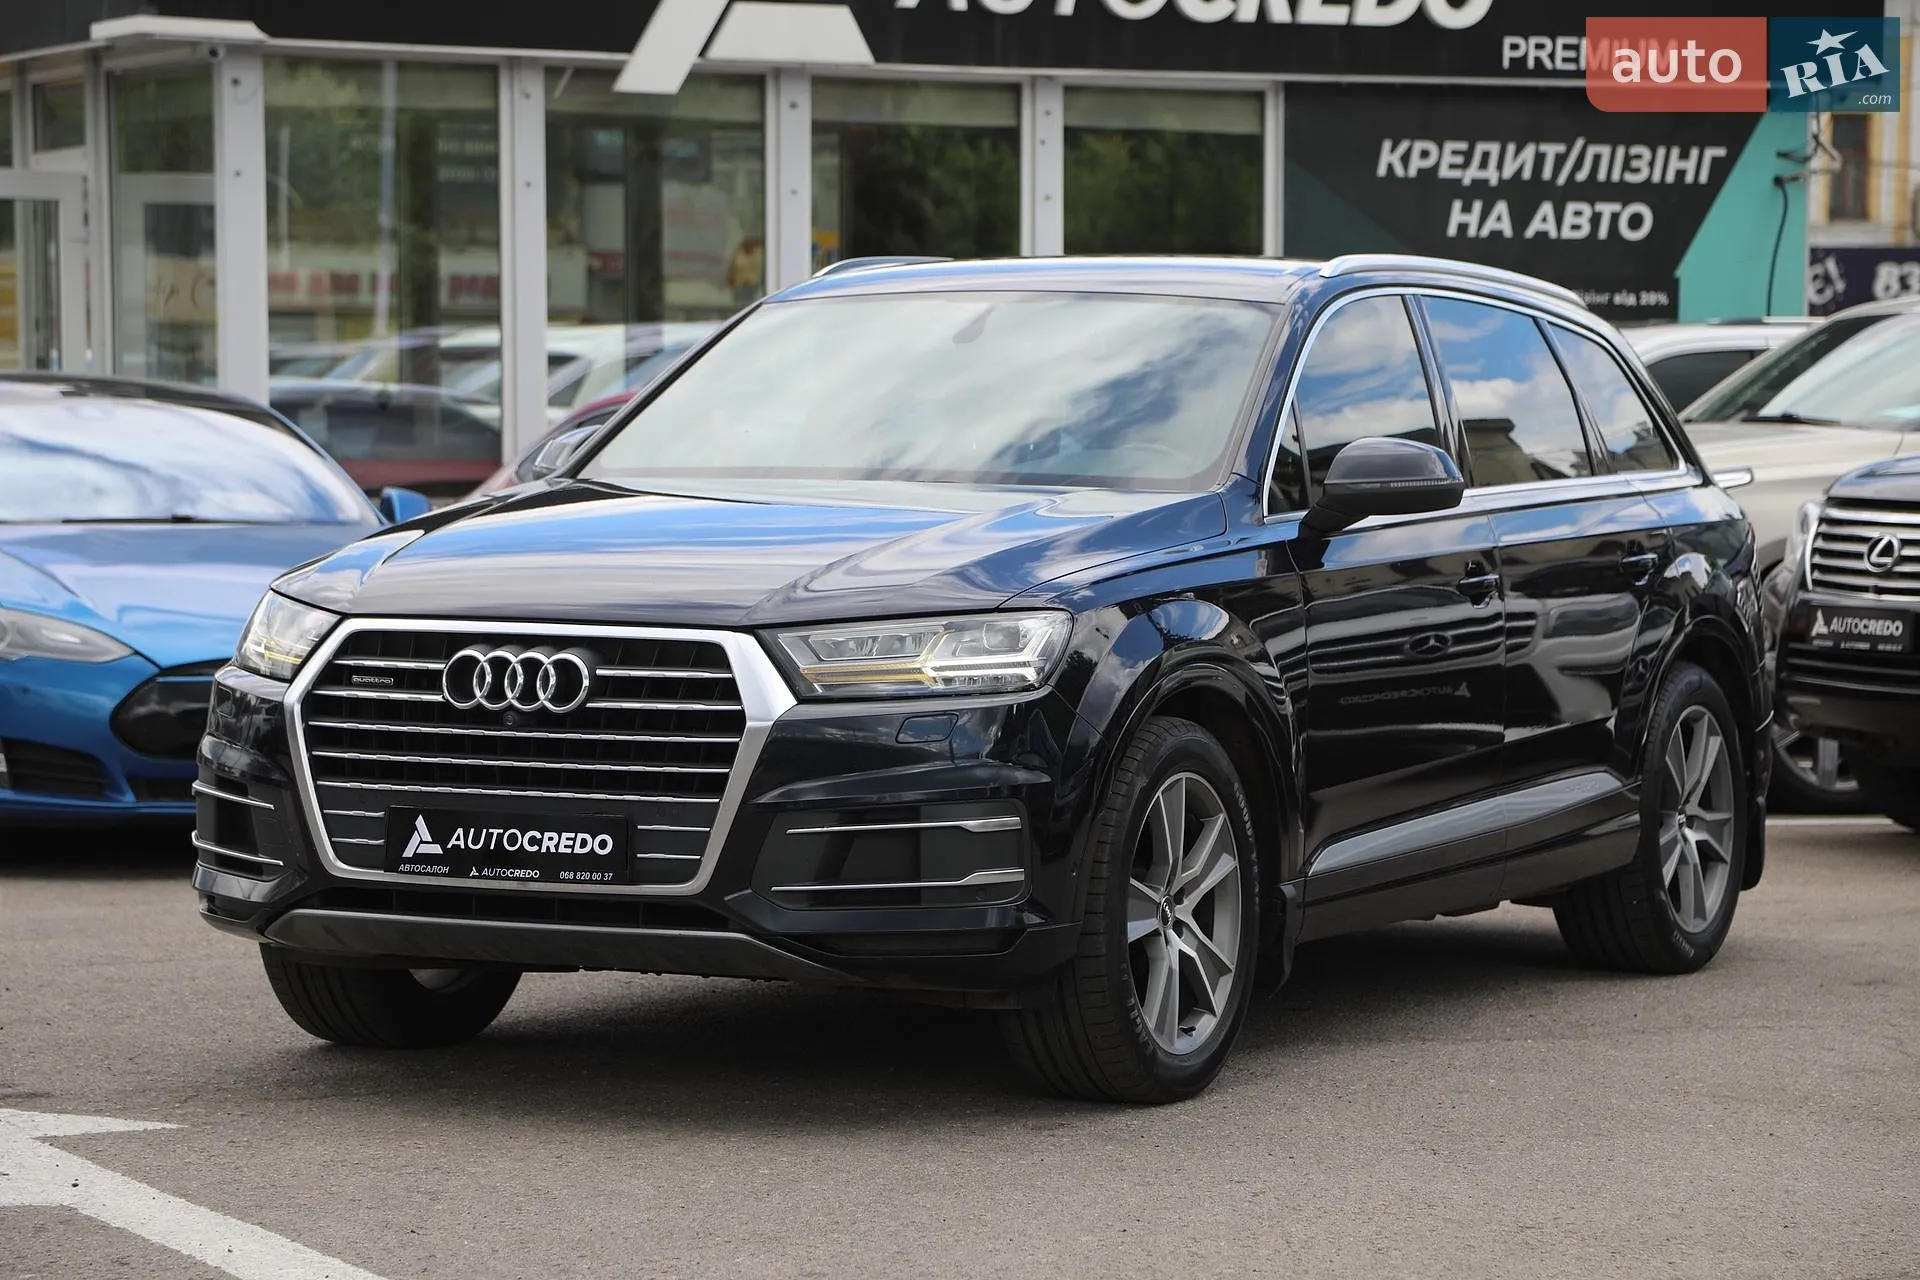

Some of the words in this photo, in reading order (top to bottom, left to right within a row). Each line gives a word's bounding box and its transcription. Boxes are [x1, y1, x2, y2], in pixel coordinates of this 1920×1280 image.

[1375, 136, 1727, 188] КРЕДИТ/ЛІЗІНГ
[1446, 198, 1515, 240] НА
[1524, 200, 1654, 242] АВТО
[1829, 615, 1904, 638] AUTOCREDO
[353, 676, 392, 685] quattro
[446, 827, 614, 856] AUTOCREDO
[398, 863, 450, 874] АВТОСАЛОН
[481, 867, 540, 879] AUTOCREDO
[559, 871, 574, 880] 068
[576, 872, 590, 881] 820
[592, 872, 602, 881] 00
[603, 872, 613, 881] 37
